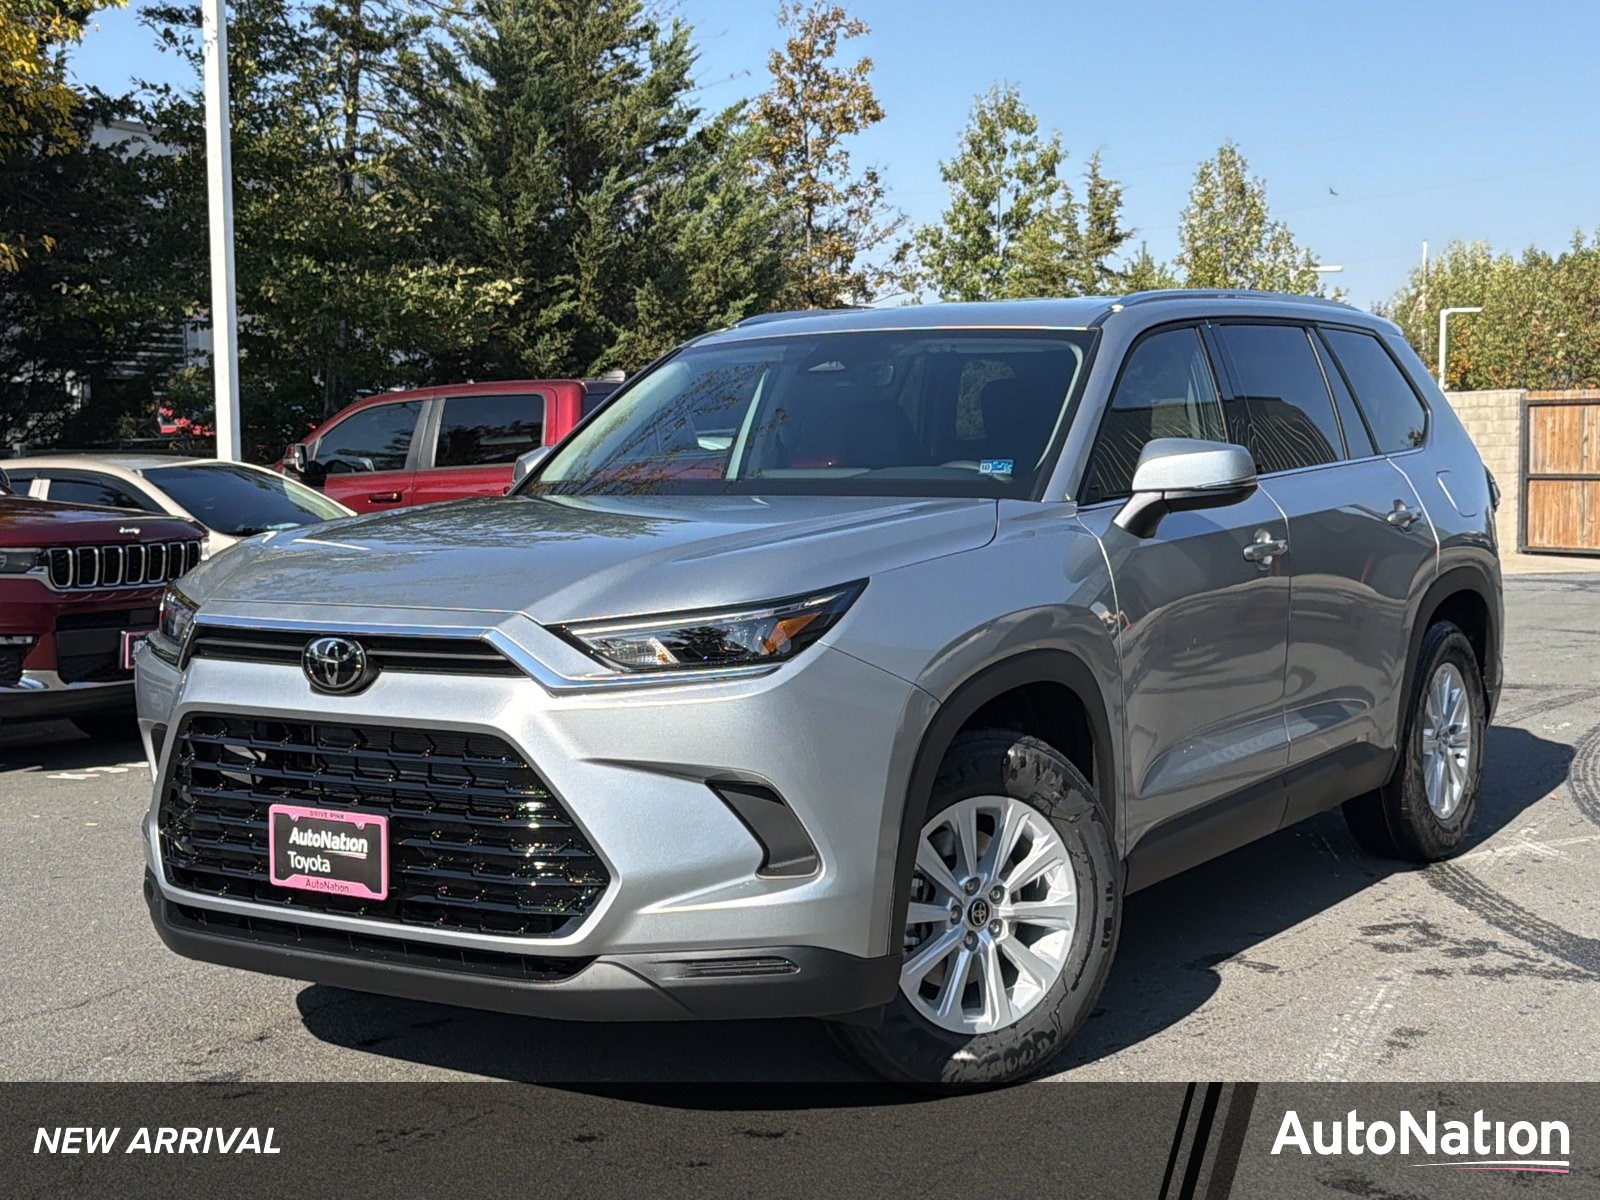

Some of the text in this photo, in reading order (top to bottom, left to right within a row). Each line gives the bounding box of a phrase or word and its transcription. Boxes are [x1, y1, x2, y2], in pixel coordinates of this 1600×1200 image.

[309, 810, 345, 820] DRIVE PINK
[288, 826, 369, 853] AutoNation
[287, 850, 331, 874] Toyota
[305, 878, 350, 893] AutoNation
